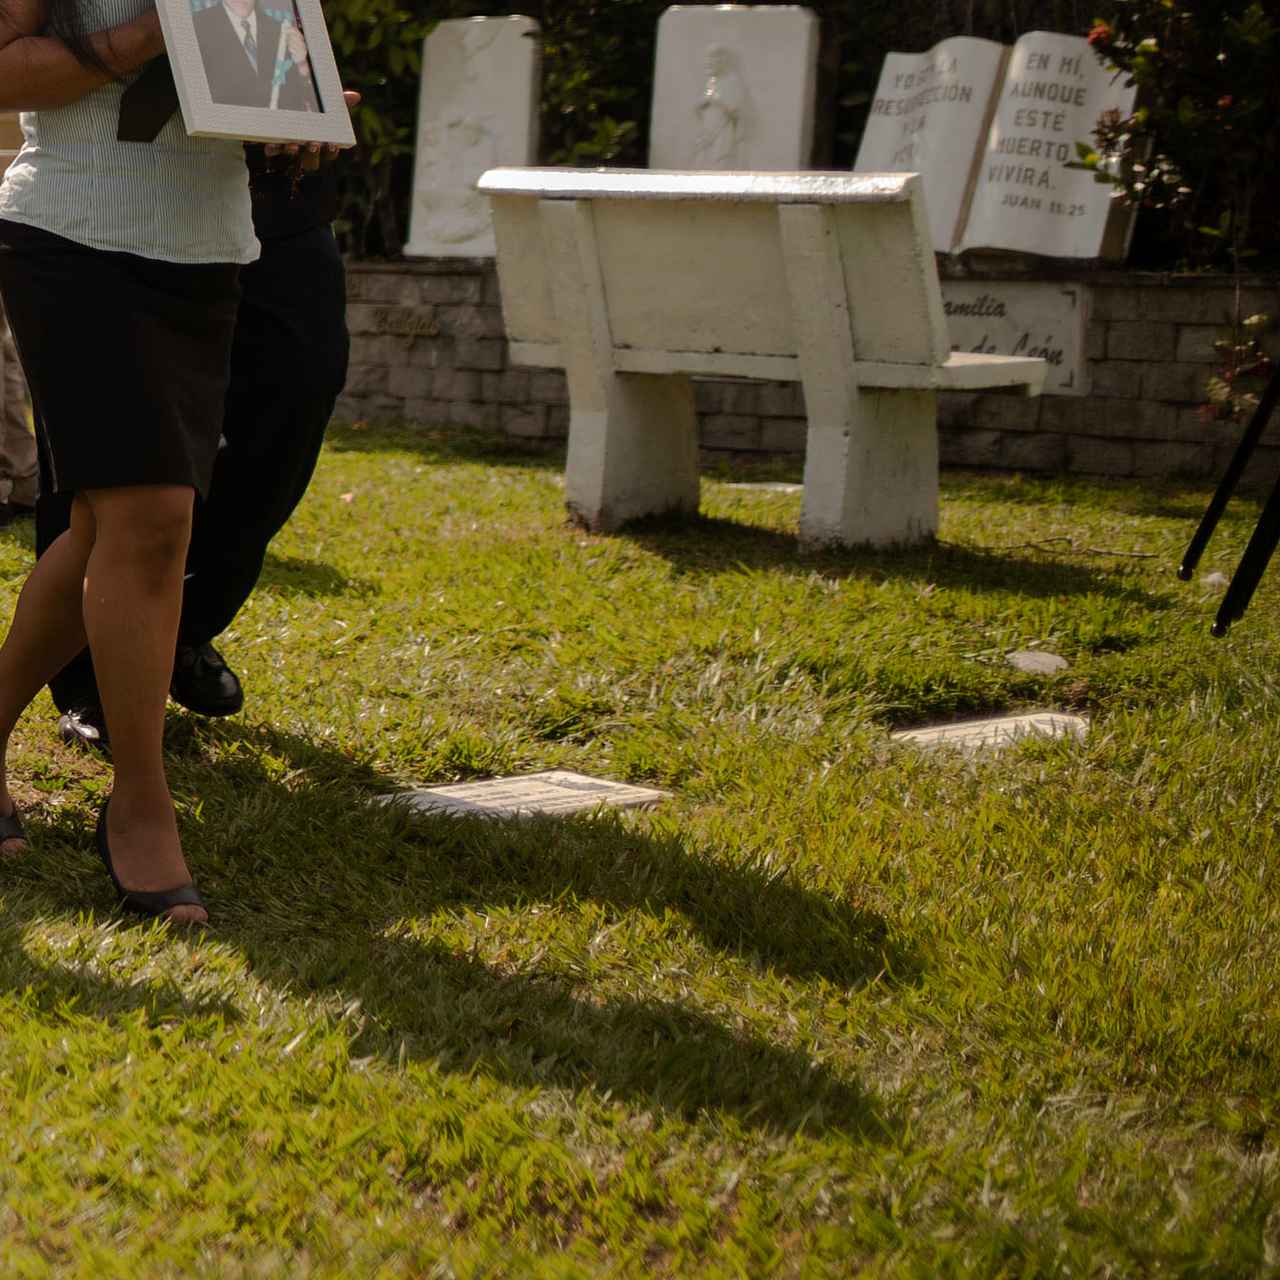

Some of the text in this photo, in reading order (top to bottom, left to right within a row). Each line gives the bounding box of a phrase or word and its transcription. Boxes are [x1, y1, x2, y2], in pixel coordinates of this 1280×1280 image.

[1025, 52, 1051, 70] EN
[1010, 81, 1088, 106] AUNQUE
[1014, 108, 1066, 132] ESTÉ
[1001, 194, 1041, 209] JUAN
[944, 294, 1007, 318] amilia
